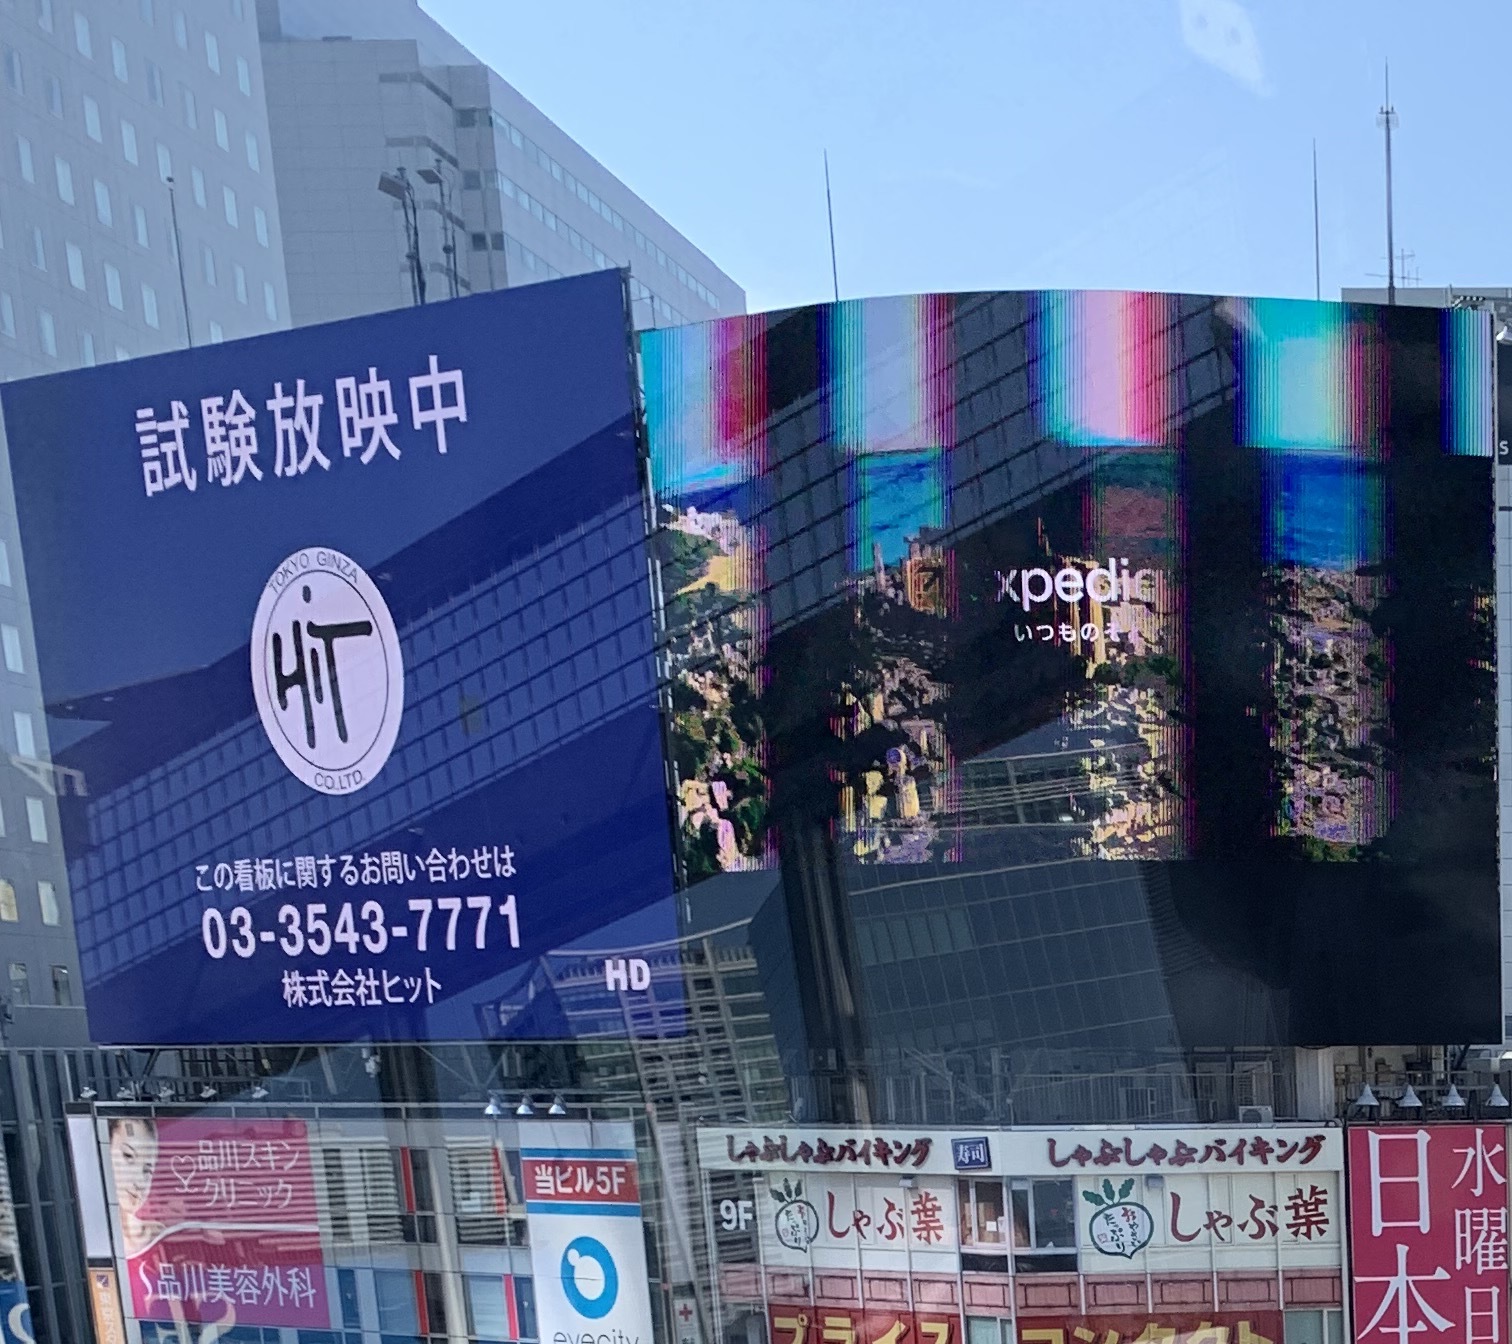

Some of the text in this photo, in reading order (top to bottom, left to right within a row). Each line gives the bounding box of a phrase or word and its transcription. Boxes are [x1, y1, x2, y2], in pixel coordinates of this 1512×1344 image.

[135, 354, 469, 498] 試験放映中
[268, 550, 359, 594] TOKYO GINZA
[195, 848, 517, 893] この看板に関するお問い合わせは
[202, 894, 522, 960] 03-3543-7771
[281, 966, 443, 1009] 株式会社ヒット
[605, 958, 651, 992] HD
[197, 1139, 300, 1171] 品川スキン
[726, 1134, 986, 1167] しゃぶしゃぶバイキング 寿司
[1047, 1134, 1327, 1168] しゃぶしゃぶバイキング
[201, 1178, 293, 1208] クリニック
[534, 1162, 629, 1197] 当ビル5F
[720, 1199, 755, 1231] 9F
[827, 1190, 944, 1245] しゃぶ葉
[1169, 1184, 1331, 1243] しゃぶ葉
[157, 1262, 317, 1309] 品川美容外科
